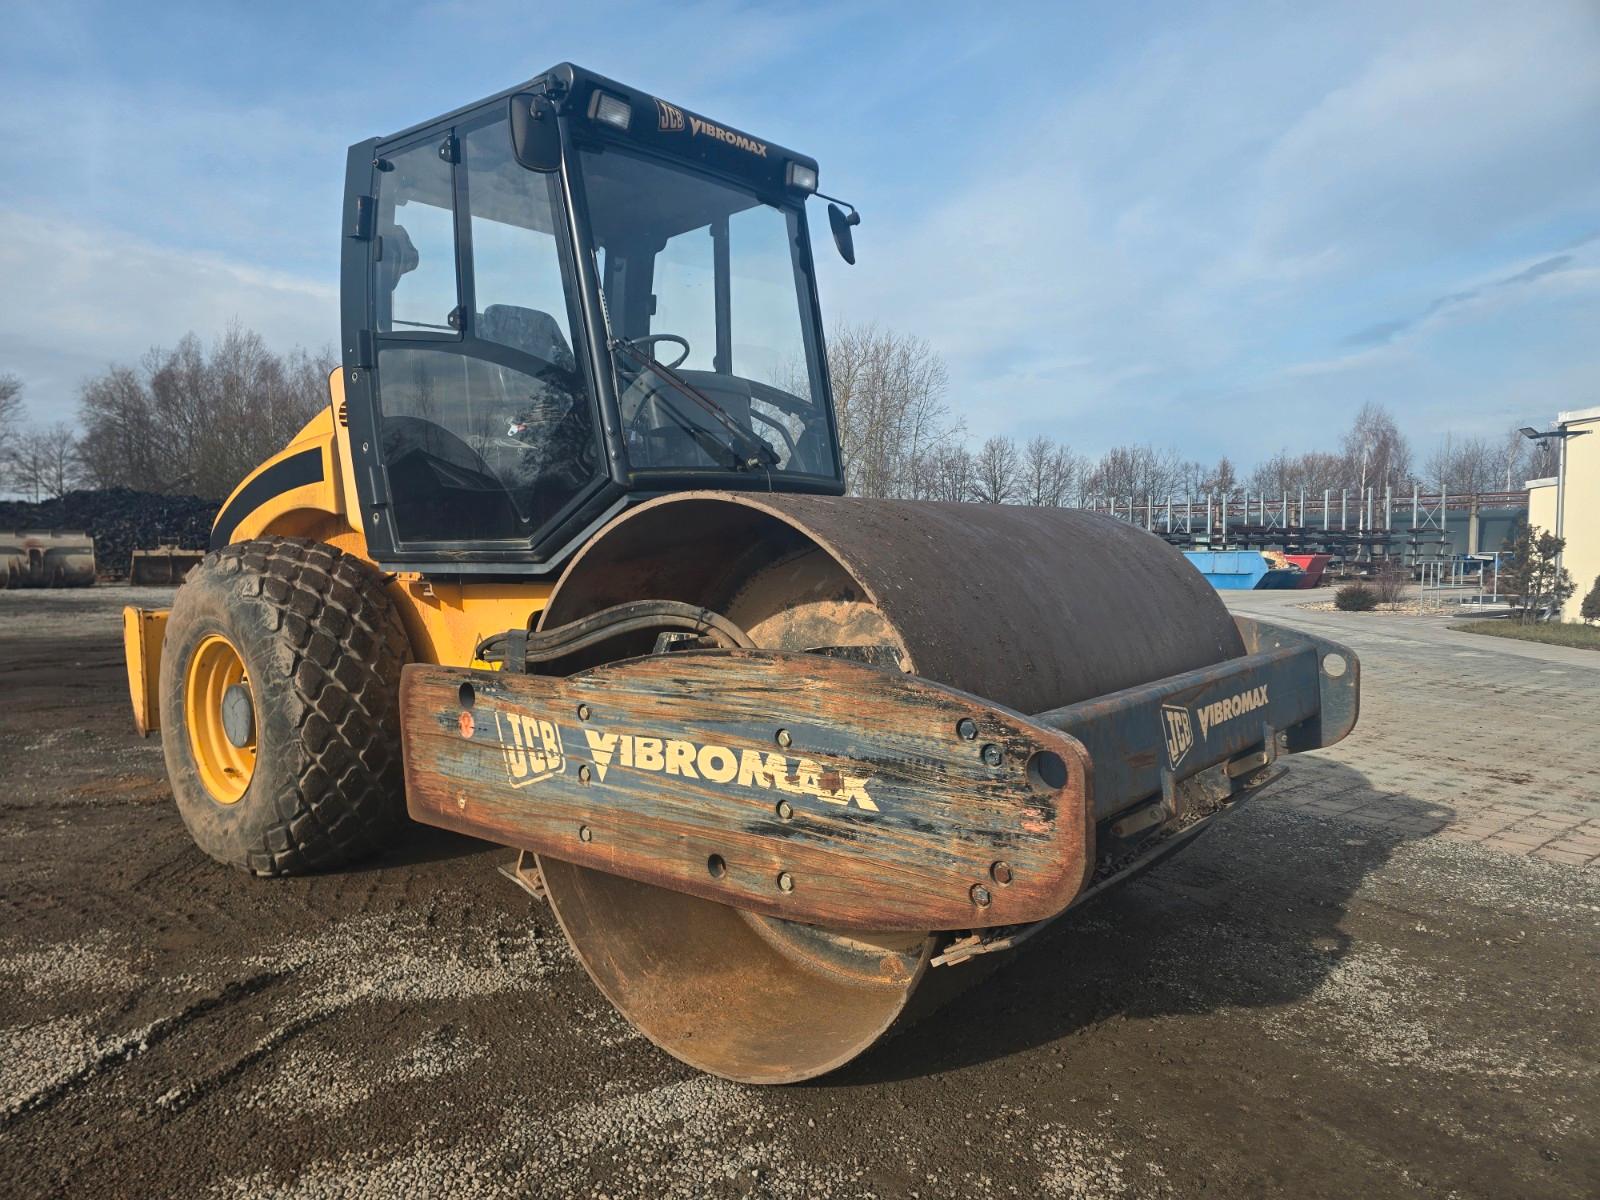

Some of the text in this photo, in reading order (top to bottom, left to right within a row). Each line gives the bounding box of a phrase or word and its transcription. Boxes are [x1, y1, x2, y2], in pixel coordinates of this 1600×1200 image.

[660, 102, 767, 158] JCB VIBROMAX
[1167, 684, 1270, 761] JCB VIBROMAX
[506, 712, 880, 812] JCB VIBROMAX
